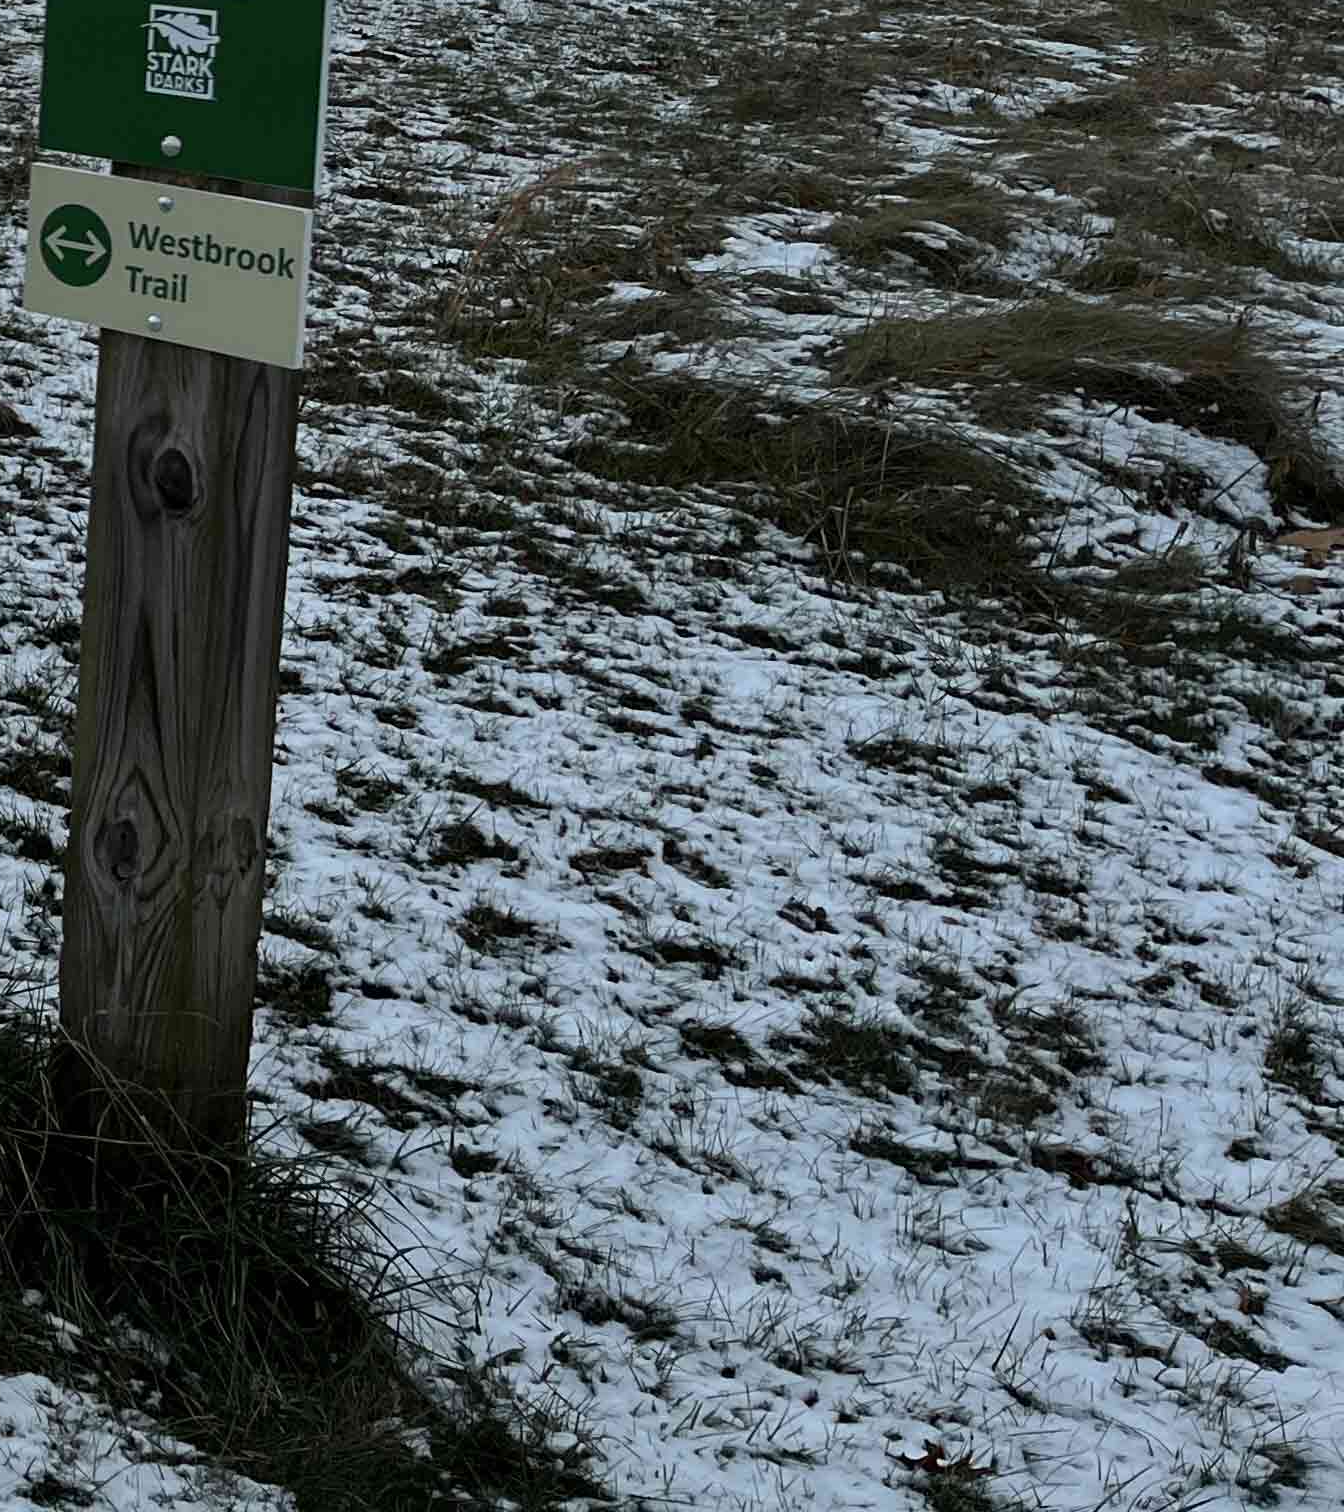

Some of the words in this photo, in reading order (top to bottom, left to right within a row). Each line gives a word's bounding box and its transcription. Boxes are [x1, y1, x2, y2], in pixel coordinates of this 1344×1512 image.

[146, 51, 214, 78] STARK
[154, 72, 205, 93] PARKS
[127, 221, 296, 279] Westbrook
[125, 265, 188, 303] Trail
